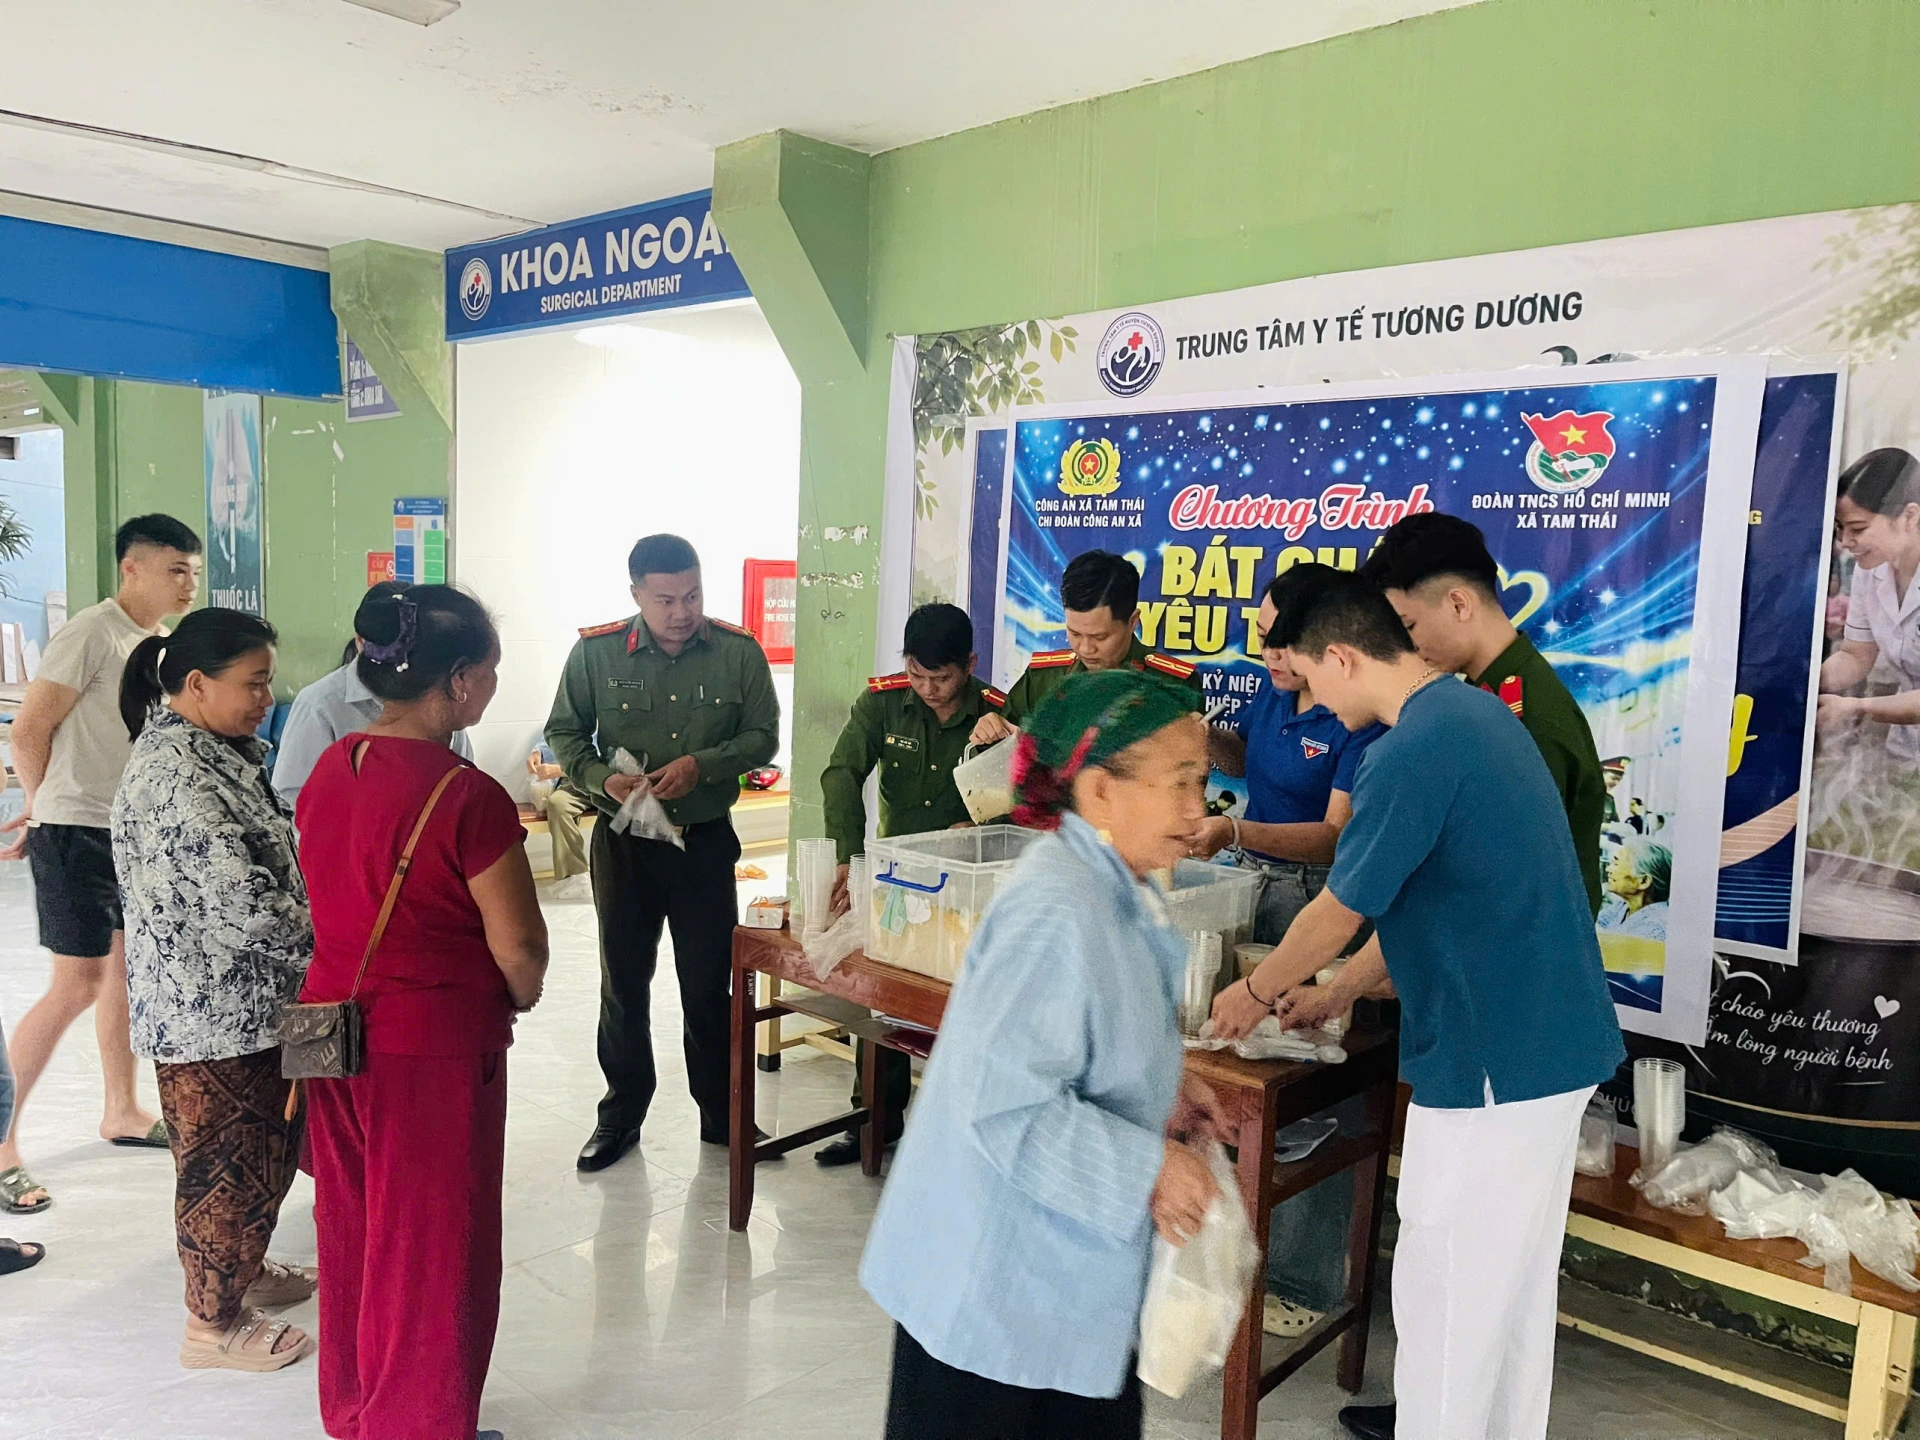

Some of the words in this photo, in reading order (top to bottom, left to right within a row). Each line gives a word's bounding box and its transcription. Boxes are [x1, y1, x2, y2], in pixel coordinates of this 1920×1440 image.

[501, 237, 593, 294] KHOA
[605, 211, 731, 276] NGOẠ
[540, 287, 598, 313] SURGICAL
[601, 274, 682, 304] DEPARTMENT
[1176, 328, 1248, 360] TRUNG
[1256, 318, 1305, 351] TÂM
[1313, 318, 1328, 344] Y
[1336, 305, 1366, 342] TẾ
[1372, 304, 1465, 339] TƯƠNG
[1475, 291, 1582, 329] DƯƠNG
[1035, 498, 1059, 511] CÔNG
[1062, 500, 1076, 511] AN
[1079, 497, 1092, 511] XÃ
[1096, 499, 1118, 511] TAM
[1121, 497, 1145, 511] THÁI
[1038, 515, 1052, 527] CHI
[1054, 513, 1081, 527] ĐOÀN
[1083, 513, 1109, 527] CÔNG
[1111, 515, 1125, 527] AN
[1128, 514, 1142, 527] XÃ
[1169, 483, 1317, 541] Chương
[1471, 491, 1514, 509] ĐOÀN
[1518, 493, 1558, 509] TNCS
[1563, 489, 1586, 509] HỒ
[1590, 490, 1620, 508] CHÍ
[1624, 492, 1671, 508] MINH
[1516, 512, 1537, 529] XÃ
[1542, 514, 1575, 529] TAM
[1579, 511, 1617, 529] THÁI
[1160, 534, 1264, 599] BÁT
[212, 582, 243, 610] THUỐC
[245, 584, 259, 611] LÁ
[1137, 597, 1228, 653] YÊU
[1202, 668, 1224, 690] KỶ
[1721, 993, 1767, 1019] cháo
[1768, 1009, 1806, 1032] yêu
[1811, 1009, 1881, 1045] thương
[1736, 1029, 1779, 1065] lòng
[1783, 1045, 1840, 1072] người
[1844, 1046, 1894, 1074] bệnh
